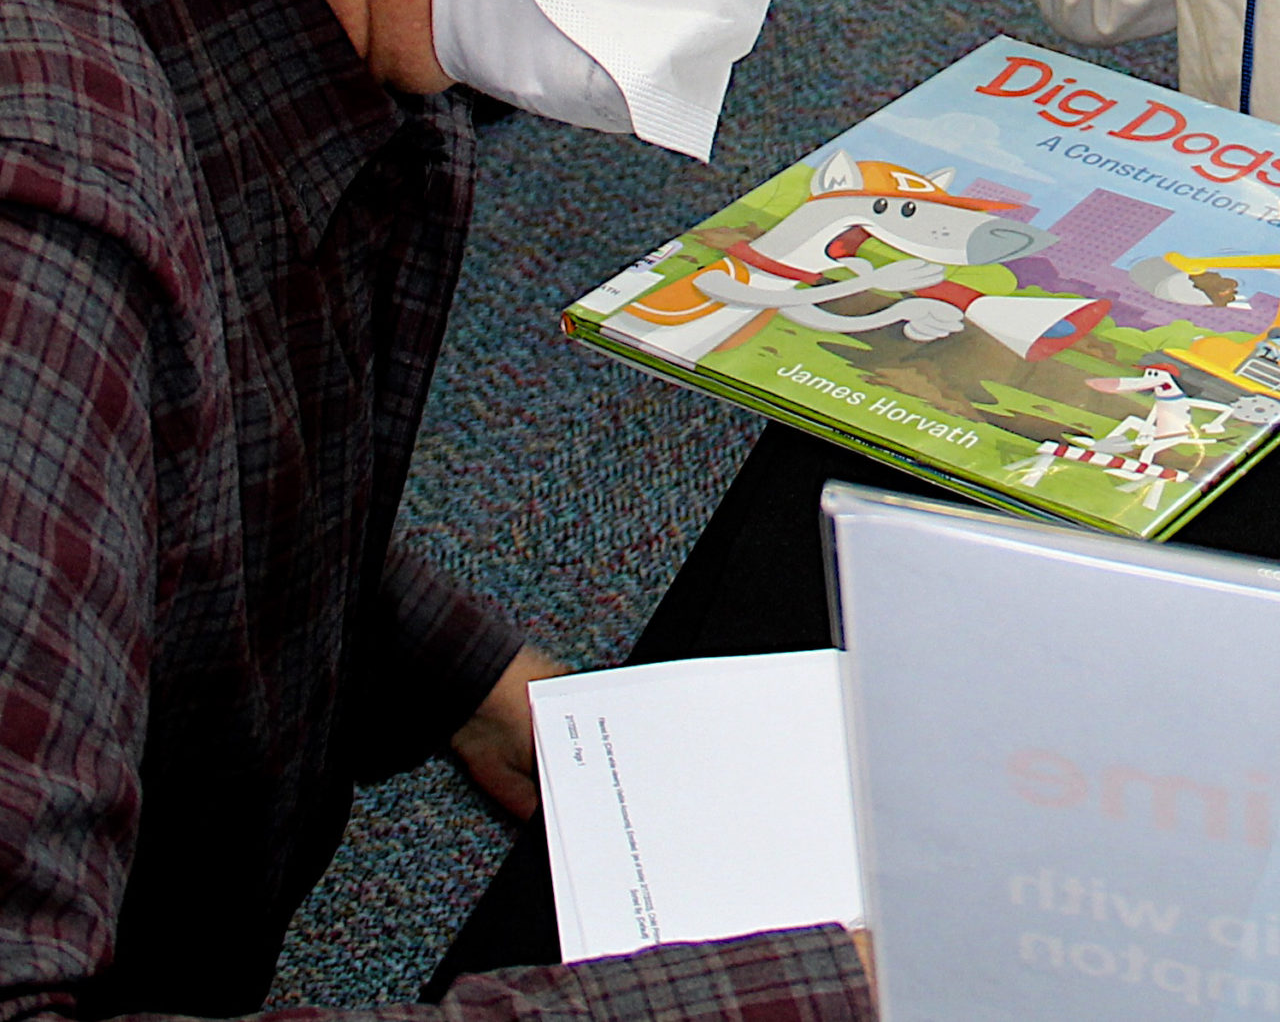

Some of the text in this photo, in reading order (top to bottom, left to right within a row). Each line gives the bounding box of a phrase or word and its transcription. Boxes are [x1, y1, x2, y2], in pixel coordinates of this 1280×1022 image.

[975, 56, 1117, 133] Dig,
[890, 171, 936, 193] D
[1037, 135, 1060, 154] A
[1063, 141, 1252, 215] Construction
[777, 360, 979, 451] James Horvath
